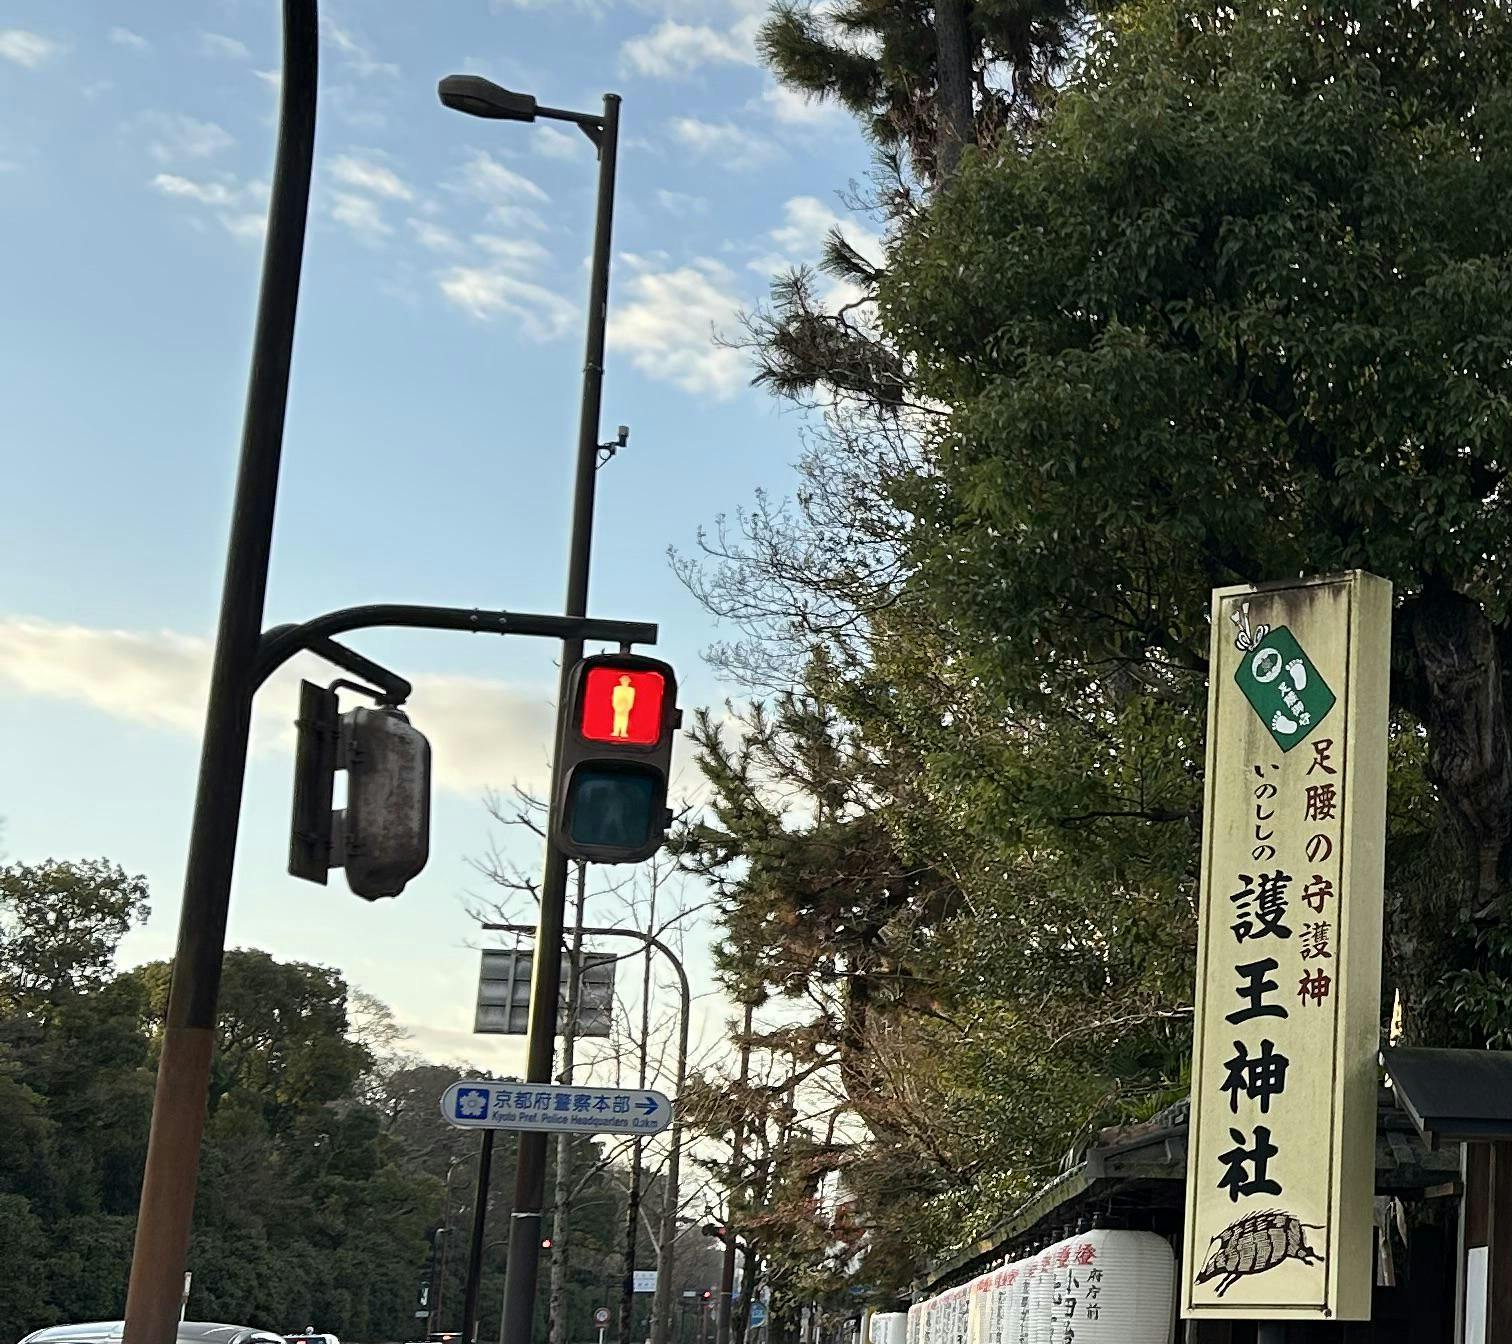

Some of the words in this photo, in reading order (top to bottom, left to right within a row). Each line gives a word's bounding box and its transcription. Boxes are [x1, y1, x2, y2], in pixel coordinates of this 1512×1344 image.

[1251, 764, 1280, 861] いのししの
[1297, 738, 1337, 1007] 足腰の守護神
[1216, 872, 1294, 1203] 護王神社
[492, 1112, 517, 1123] Kyoto
[541, 1115, 568, 1124] Police
[493, 1090, 630, 1113] 京都府警察本部
[1086, 1268, 1104, 1320] 府庁前
